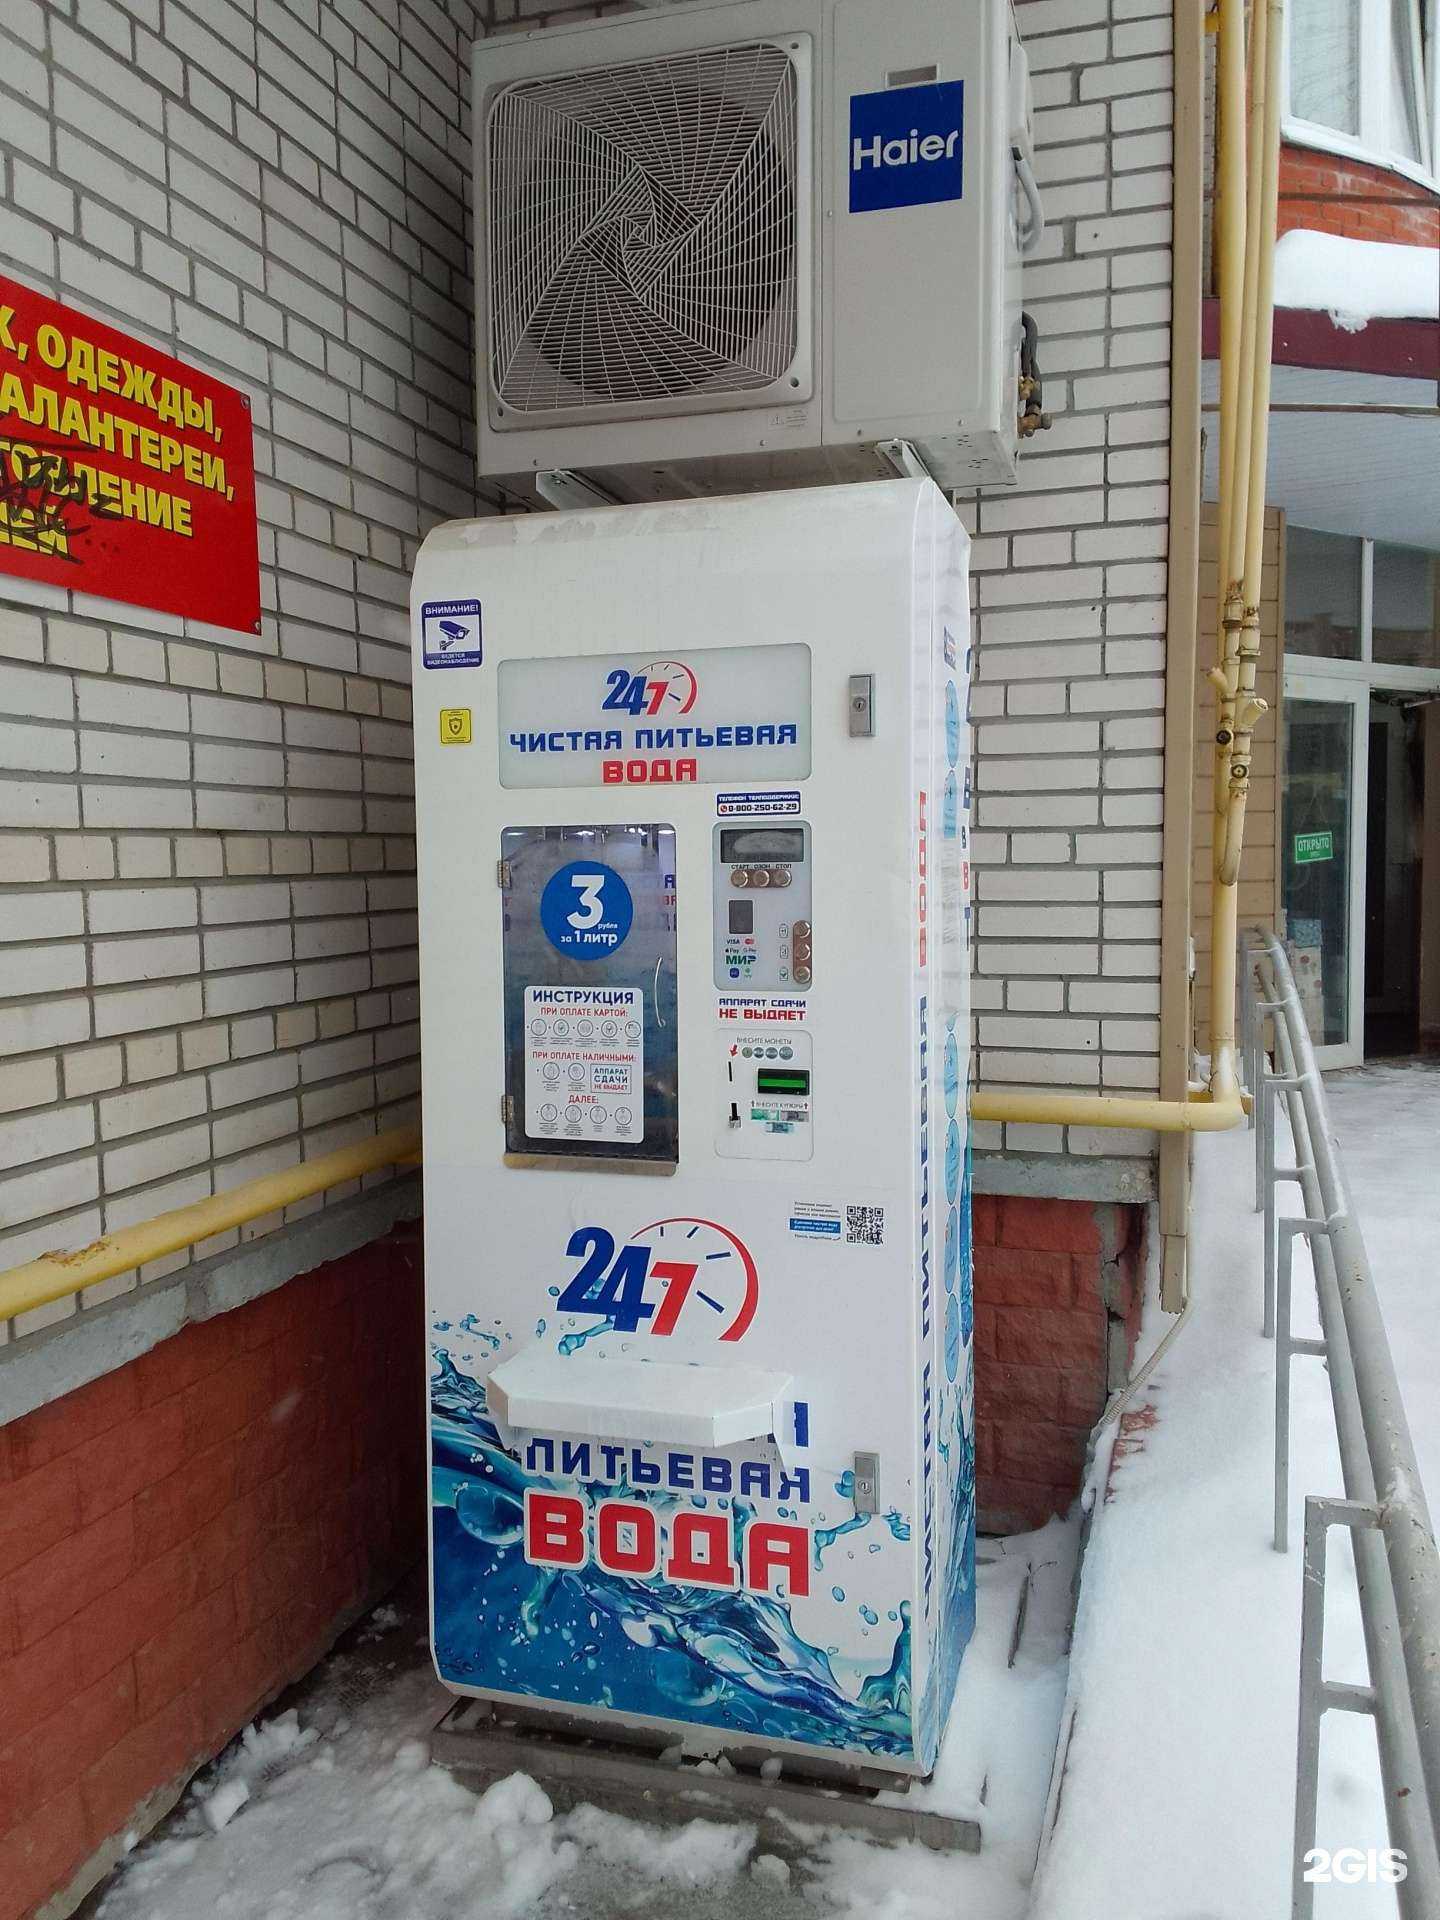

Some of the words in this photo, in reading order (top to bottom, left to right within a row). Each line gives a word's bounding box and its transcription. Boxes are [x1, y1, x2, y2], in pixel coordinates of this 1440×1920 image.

[853, 128, 959, 171] Haier
[37, 324, 223, 442] ОДЕЖДЫ,
[425, 604, 479, 615] ВНИМАНИЕ!
[510, 730, 622, 752] ЧИСТАЯ
[635, 724, 797, 749] ПИТЬЕВАЯ
[603, 758, 697, 784] ВОДА
[566, 874, 605, 930] 3
[574, 930, 581, 943] 1
[583, 933, 618, 947] литр
[725, 955, 757, 965] МИР
[533, 990, 634, 1006] ИНСТРУКЦИЯ
[719, 998, 767, 1006] АППАРАТ
[771, 1000, 806, 1008] СДАЧИ
[540, 1008, 557, 1016] ПРИ
[560, 1008, 591, 1016] ОПЛАТЕ
[594, 1008, 628, 1017] КАРТОЙ:
[719, 1008, 738, 1019] НЕ
[743, 1009, 806, 1021] ВЫДАЕТ
[532, 1051, 548, 1059] ПРИ
[550, 1052, 580, 1061] ОПЛАТЕ
[594, 1075, 628, 1083] СДАЧИ
[568, 1095, 599, 1104] ДАЛЕЕ:
[526, 1438, 811, 1503] ПИТЬЕВАЯ
[528, 1493, 810, 1597] ВОДА
